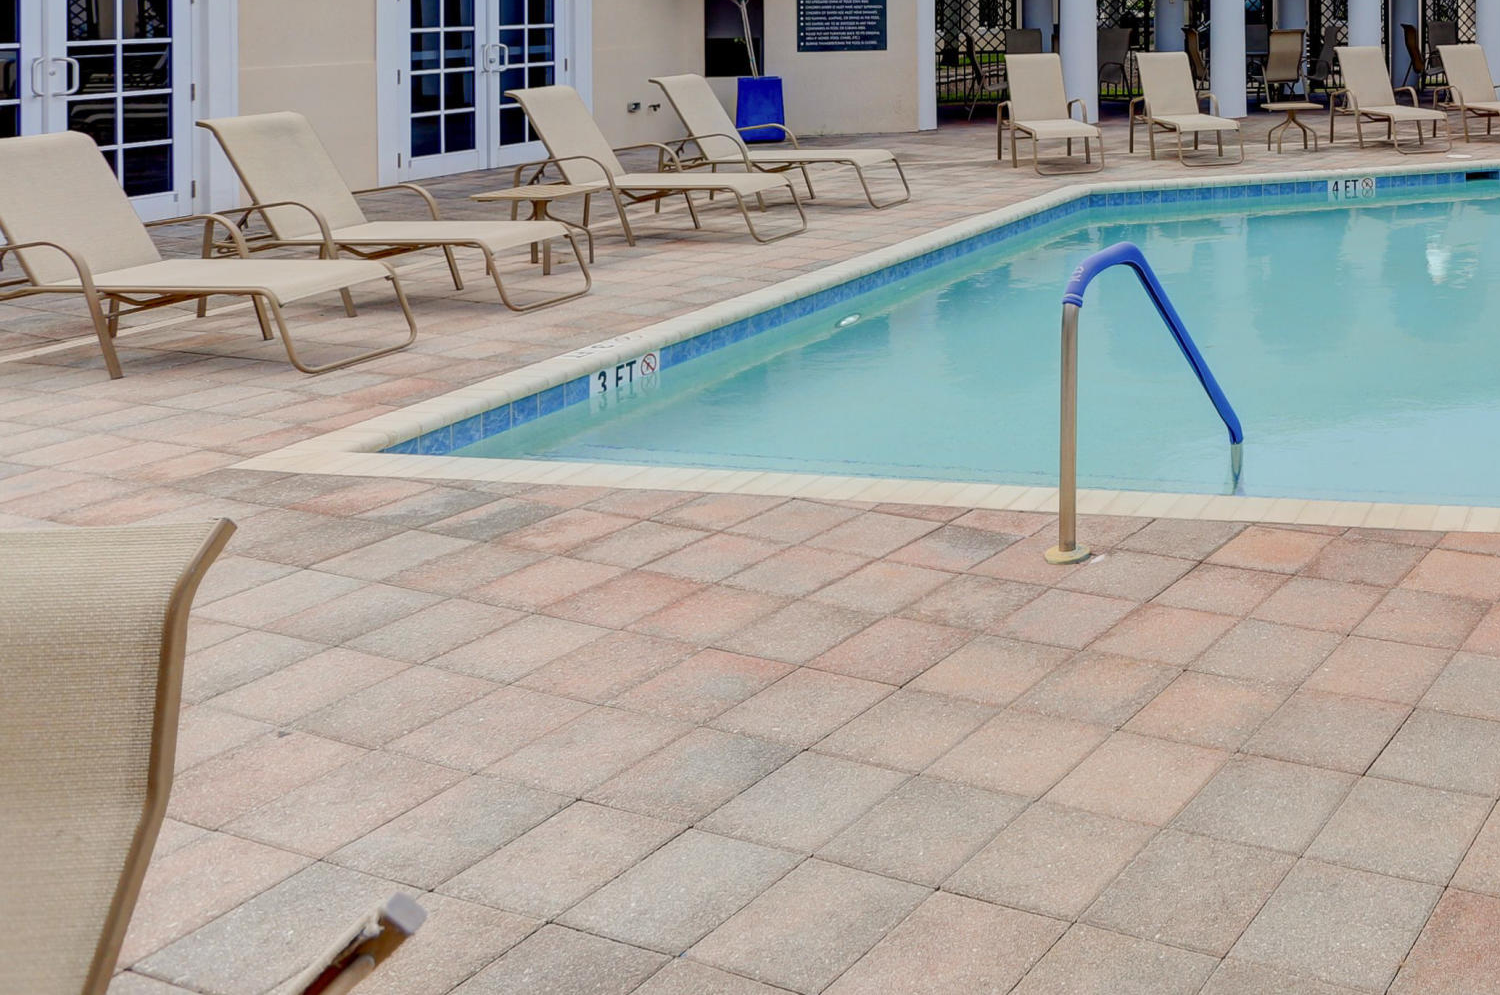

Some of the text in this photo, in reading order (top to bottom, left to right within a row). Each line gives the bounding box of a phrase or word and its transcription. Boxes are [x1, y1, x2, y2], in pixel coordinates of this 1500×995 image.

[1332, 179, 1359, 191] 4 FT
[598, 359, 637, 394] 3 FT
